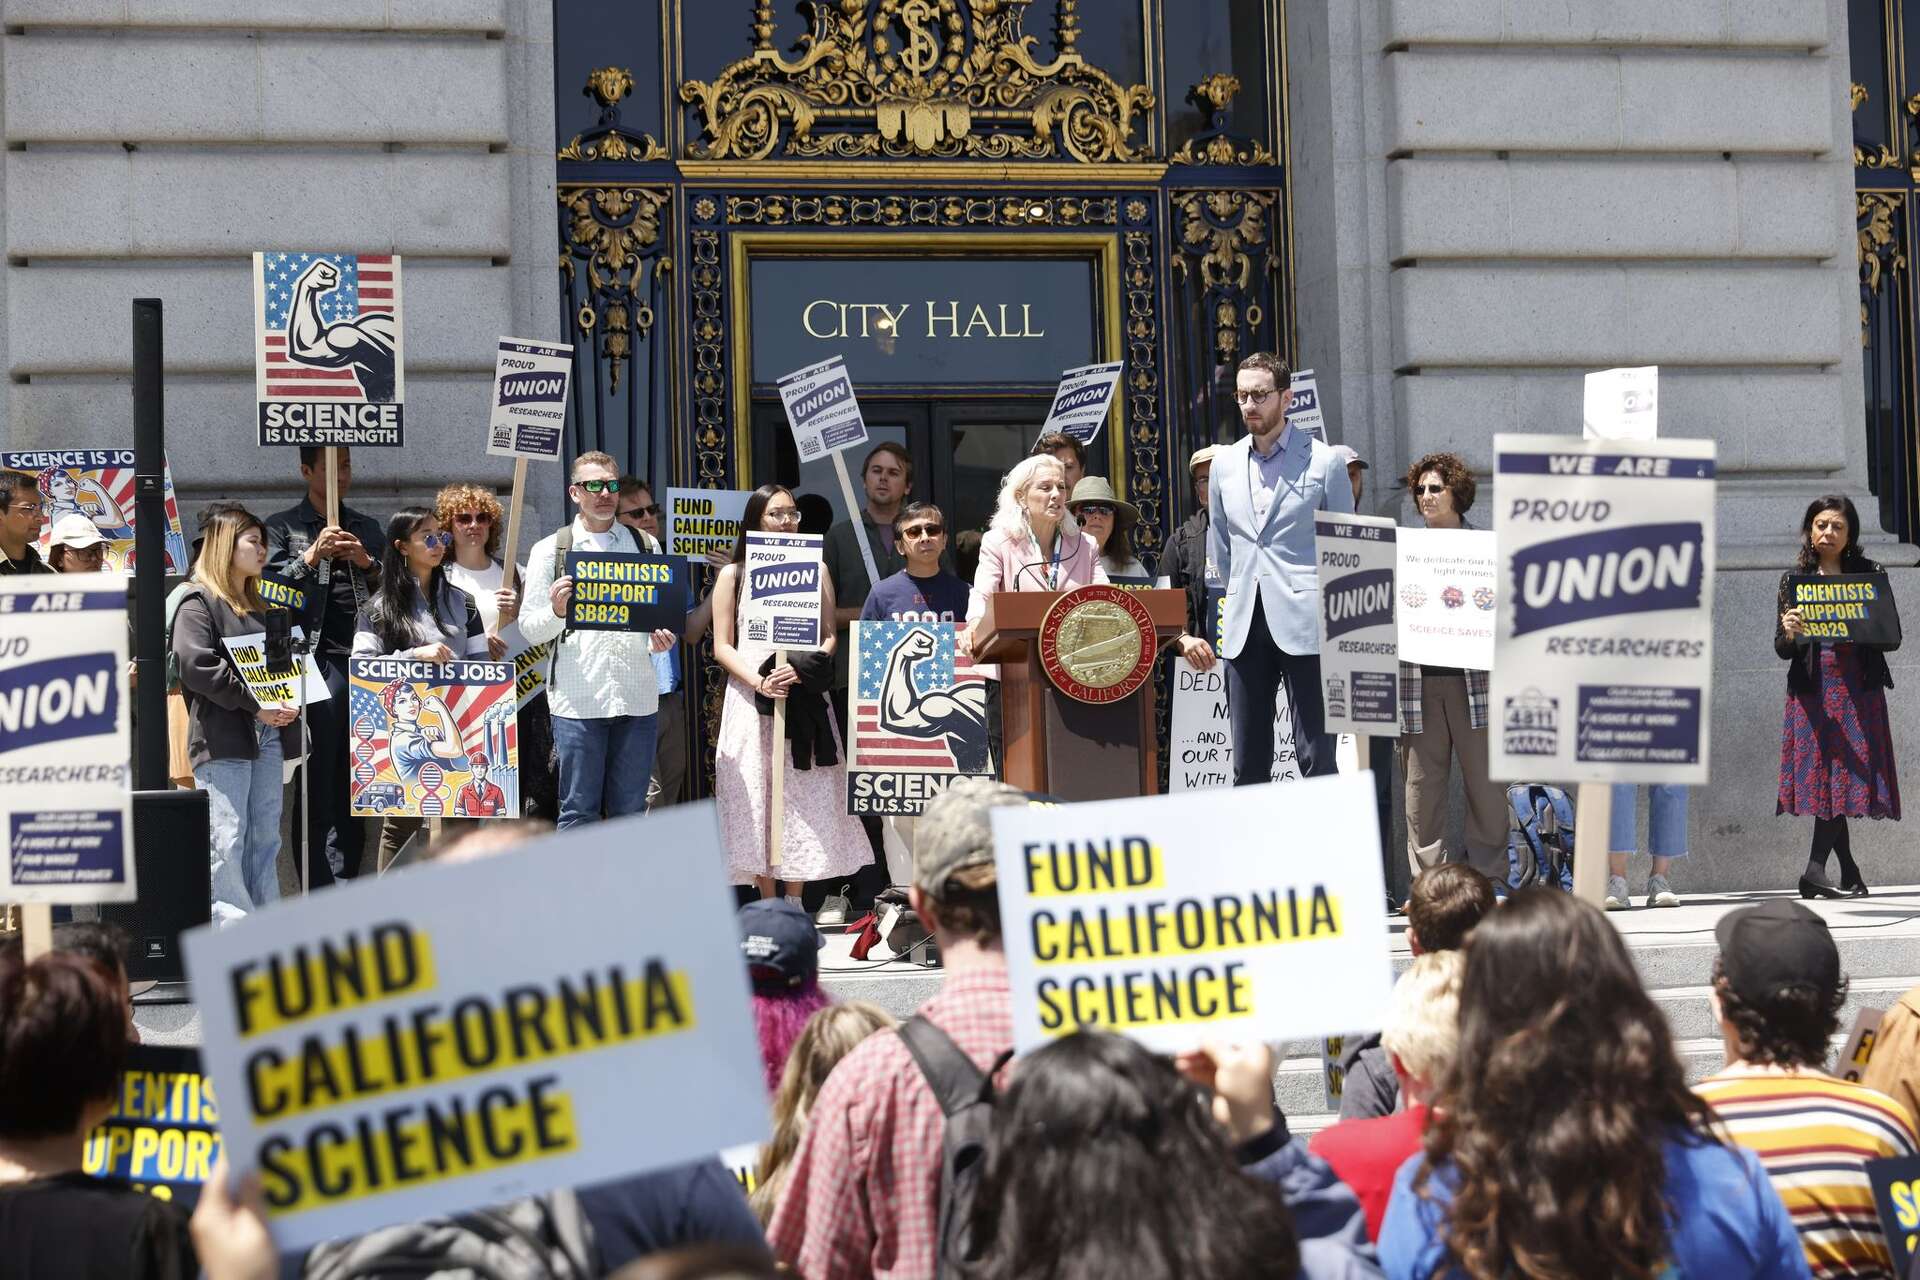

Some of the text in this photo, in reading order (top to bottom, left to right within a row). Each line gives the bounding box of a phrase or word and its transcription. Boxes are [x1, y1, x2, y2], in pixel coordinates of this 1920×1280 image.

[803, 300, 1045, 338] CITY HALL
[516, 345, 557, 356] WE ARE
[501, 359, 535, 370] PROUD
[503, 379, 562, 397] UNION
[785, 382, 816, 399] PROUD
[795, 383, 846, 417] UNION
[1057, 386, 1107, 411] UNION
[265, 403, 398, 428] SCIENCE
[509, 406, 563, 420] RESEARCHERS
[807, 405, 857, 428] RESEARCHERS
[266, 429, 398, 443] IS U.S. STRENGTH
[10, 451, 86, 468] SCIENCE
[91, 451, 108, 465] IS
[1549, 455, 1671, 477] WE ARE
[673, 497, 712, 515] FUND
[1510, 498, 1611, 523] PROUD
[1334, 525, 1380, 539] WE ARE
[750, 552, 786, 562] PROUD
[1322, 551, 1360, 569] PROUD
[575, 560, 670, 583] SCIENTISTS
[755, 569, 815, 590] UNION
[1523, 540, 1696, 609] UNION
[31, 592, 84, 612] ARE
[575, 582, 655, 604] SUPPORT
[1329, 581, 1391, 622] UNION
[1796, 583, 1875, 602] SCIENTISTS
[575, 603, 630, 624] SB829
[763, 599, 819, 609] RESEARCHERS
[1052, 592, 1086, 622] SEAL
[1108, 589, 1153, 636] SENATE
[1797, 602, 1865, 620] SUPPORT
[1409, 624, 1455, 636] SCIENCE
[1802, 622, 1849, 637] SB829
[231, 645, 259, 664] FUND
[1338, 639, 1396, 656] RESEARCHERS
[1546, 636, 1704, 658] RESEARCHERS
[357, 660, 507, 682] SCIENCE IS JOBS
[1044, 625, 1061, 676] STATE
[1069, 662, 1151, 701] CALIFORNIA
[251, 683, 293, 702] SCIENCE
[1182, 749, 1218, 764] OUR
[1185, 772, 1227, 788] WITH
[854, 798, 868, 813] IS
[872, 798, 902, 813] U.S.
[1022, 834, 1153, 895] FUND
[1029, 883, 1337, 962] CALIFORNIA
[230, 918, 422, 1036] FUND
[1036, 961, 1249, 1029] SCIENCE
[244, 956, 686, 1120] CALIFORNIA
[256, 1075, 572, 1208] SCIENCE
